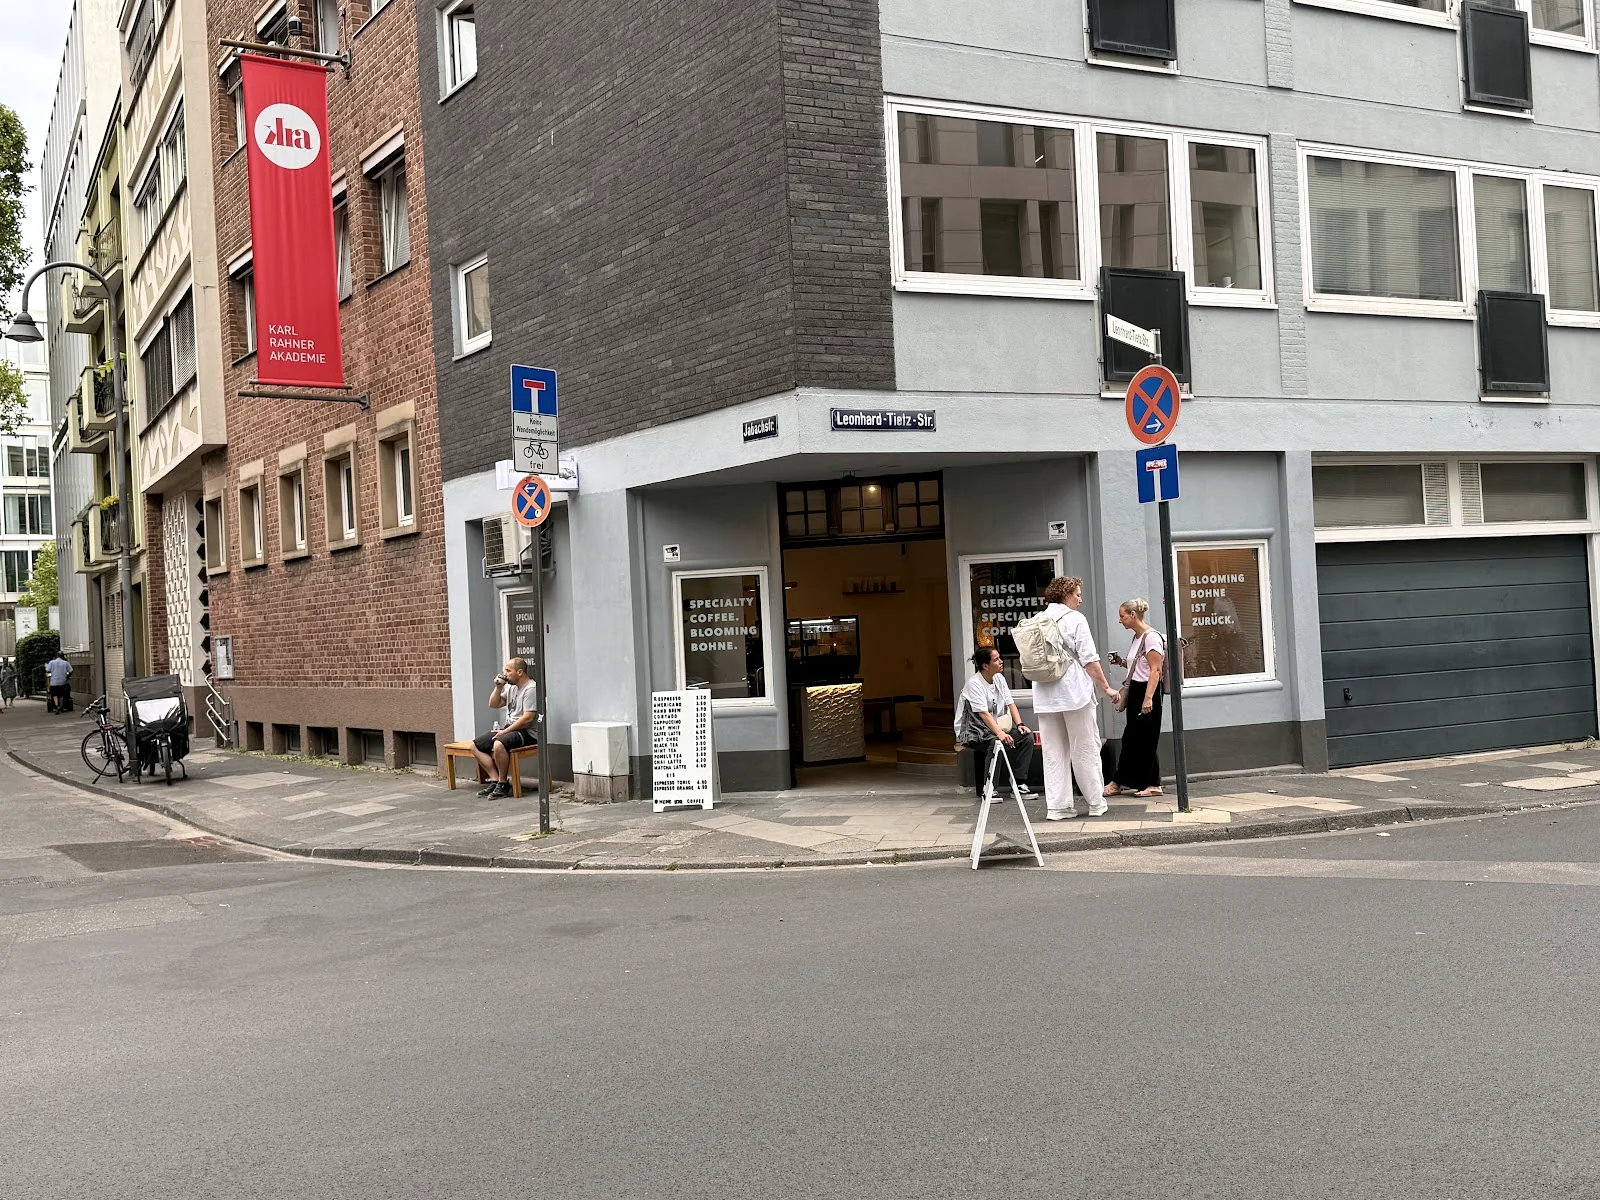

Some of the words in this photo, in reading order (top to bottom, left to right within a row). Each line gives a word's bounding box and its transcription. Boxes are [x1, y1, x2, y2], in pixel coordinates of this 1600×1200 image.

[269, 324, 298, 336] KARL
[269, 337, 314, 350] RAHNER
[269, 350, 326, 364] AKADEMIE
[529, 417, 542, 426] Keine
[516, 425, 556, 437] Wendemöglichkeit
[743, 419, 775, 437] Jabachstr.
[530, 460, 544, 470] frei
[1189, 573, 1245, 585] BLOOMING
[979, 583, 1026, 595] FRISCH
[1190, 588, 1226, 599] BOHNE
[689, 597, 754, 609] SPECIALTY
[980, 595, 1049, 609] GERÖSTET.
[1191, 603, 1207, 613] IST
[689, 612, 740, 624] COFFEE.
[1192, 612, 1235, 627] ZURÜCK.
[690, 626, 757, 638] BLOOMING
[690, 641, 738, 652] BOHNE.
